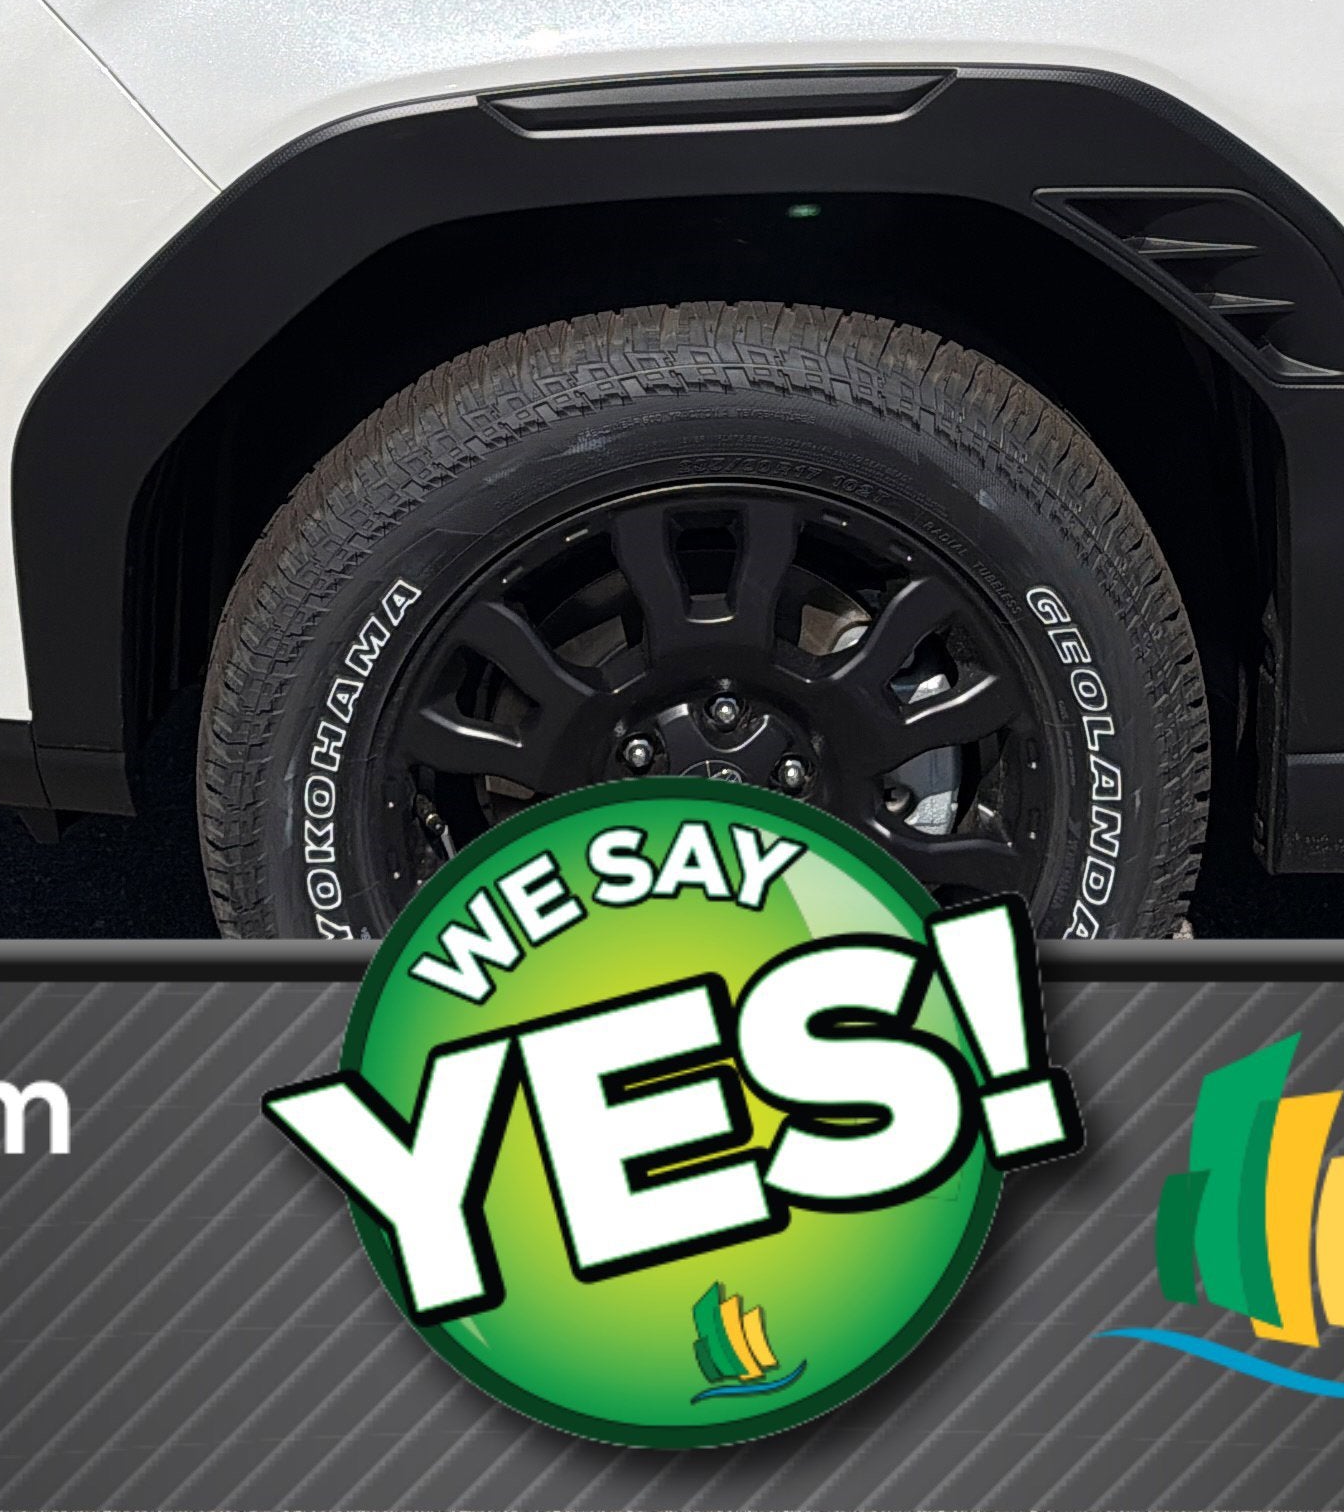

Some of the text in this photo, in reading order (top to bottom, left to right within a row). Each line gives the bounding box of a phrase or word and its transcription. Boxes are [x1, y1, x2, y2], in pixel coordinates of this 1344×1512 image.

[921, 520, 1023, 616] RADIAL TUBELESS
[304, 579, 422, 939] YOKOHAMA
